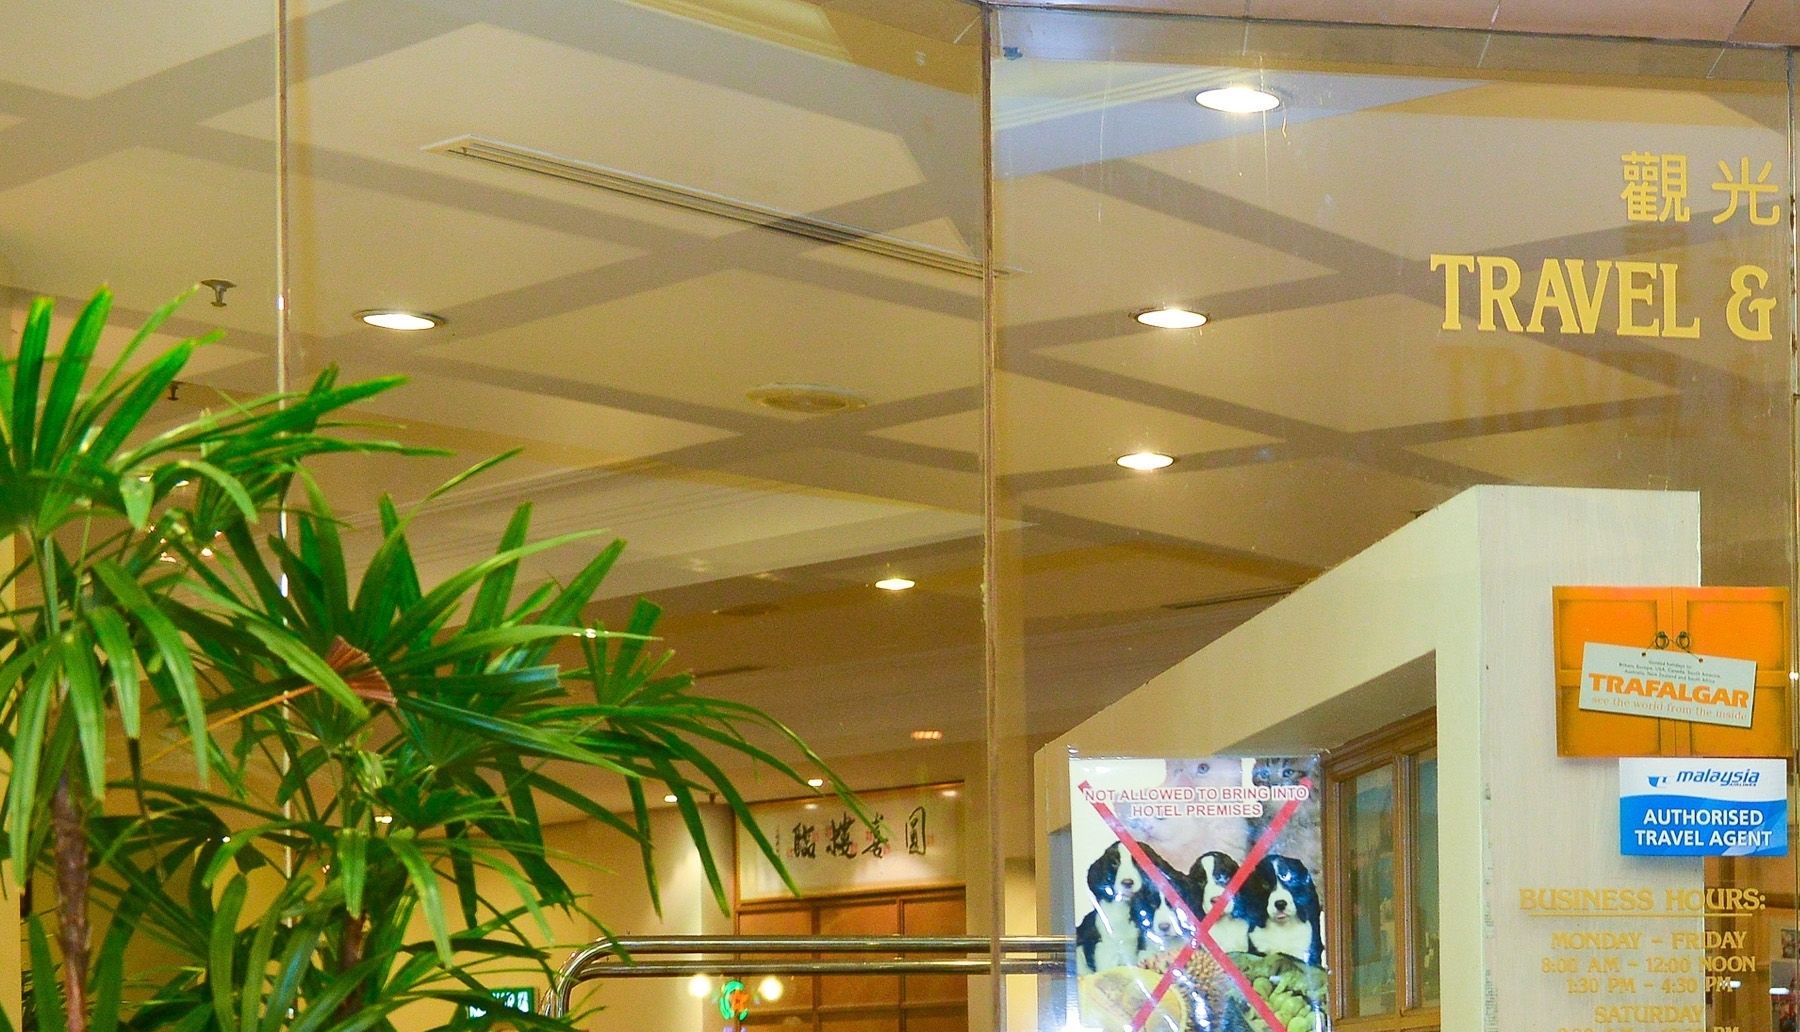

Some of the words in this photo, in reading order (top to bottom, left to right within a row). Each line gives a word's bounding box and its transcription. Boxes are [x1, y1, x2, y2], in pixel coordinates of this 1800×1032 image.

[1431, 253, 1701, 340] TRAVEL
[1726, 264, 1778, 342] &
[1588, 673, 1749, 708] TRAFALGAR
[1676, 768, 1760, 788] malaysia
[1085, 788, 1115, 801] NOT
[1120, 788, 1194, 800] ALLOWED
[1199, 788, 1218, 800] TO
[1222, 787, 1270, 800] BRING
[1272, 785, 1307, 799] INTO
[1133, 804, 1181, 817] HOTEL
[1186, 803, 1261, 816] PREMISES
[1643, 808, 1764, 827] AUTHORISED
[1634, 829, 1705, 848] TRAVEL
[1709, 830, 1773, 849] AGENT
[1551, 931, 1642, 950] MONDAY
[1671, 931, 1747, 950] FRIDAY
